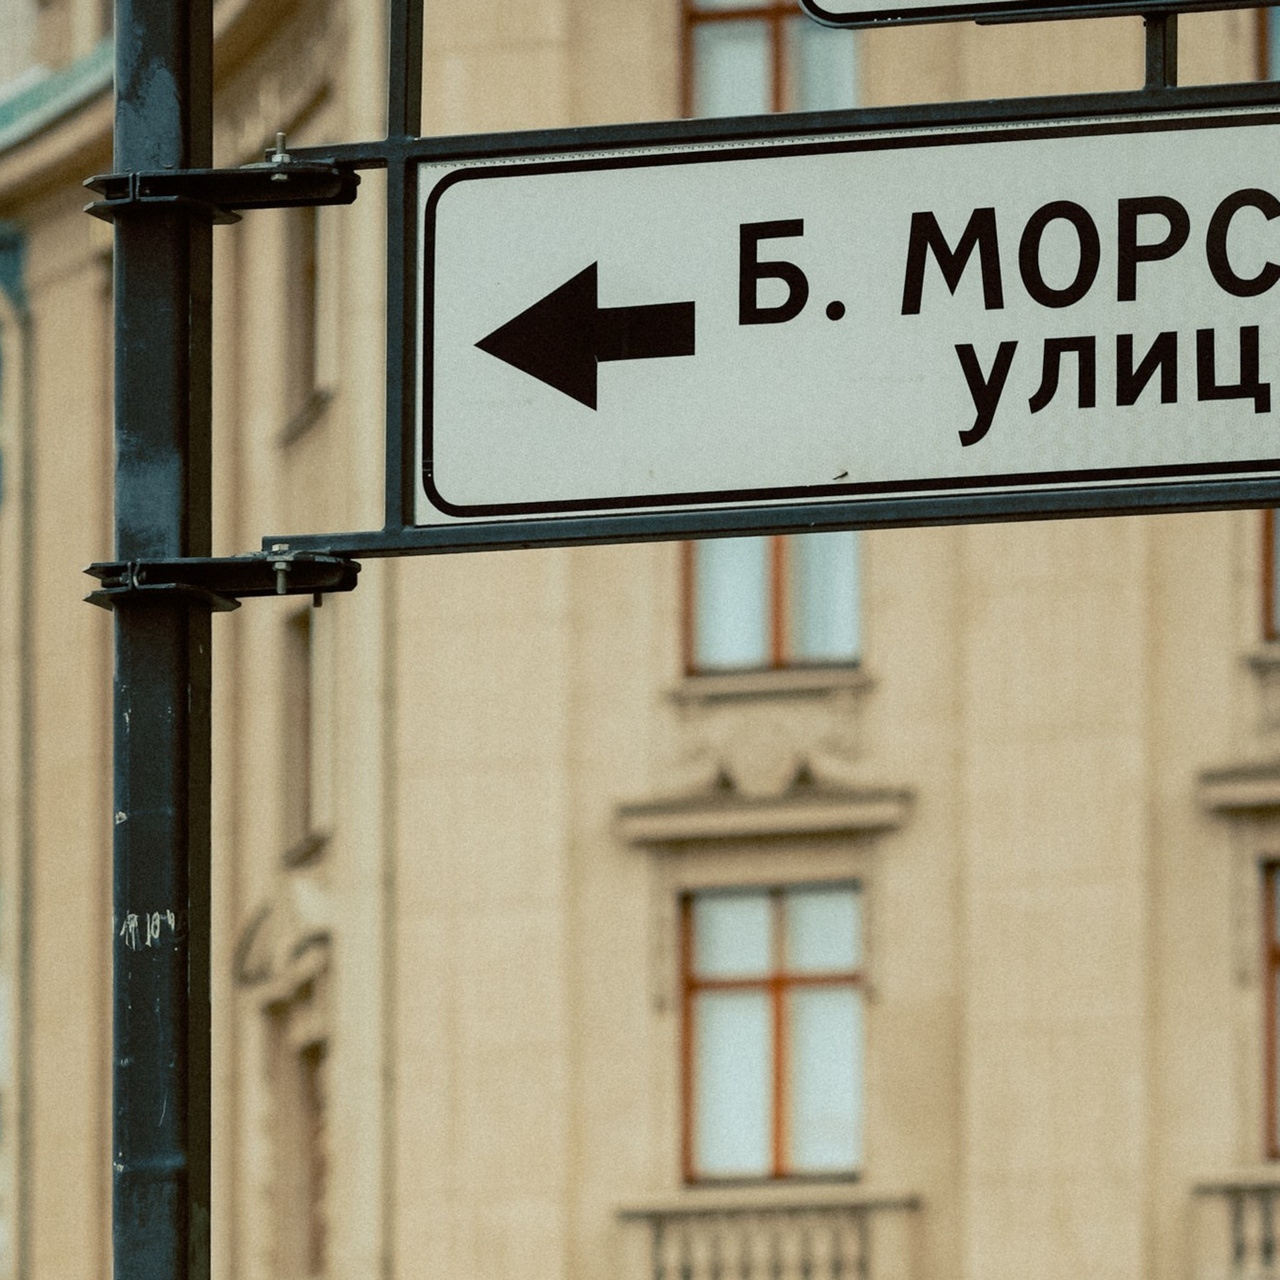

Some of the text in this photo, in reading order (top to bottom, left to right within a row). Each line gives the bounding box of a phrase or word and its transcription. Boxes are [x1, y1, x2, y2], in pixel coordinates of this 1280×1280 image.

[738, 187, 1280, 326] Б. МОРС
[954, 325, 1272, 447] улиц
